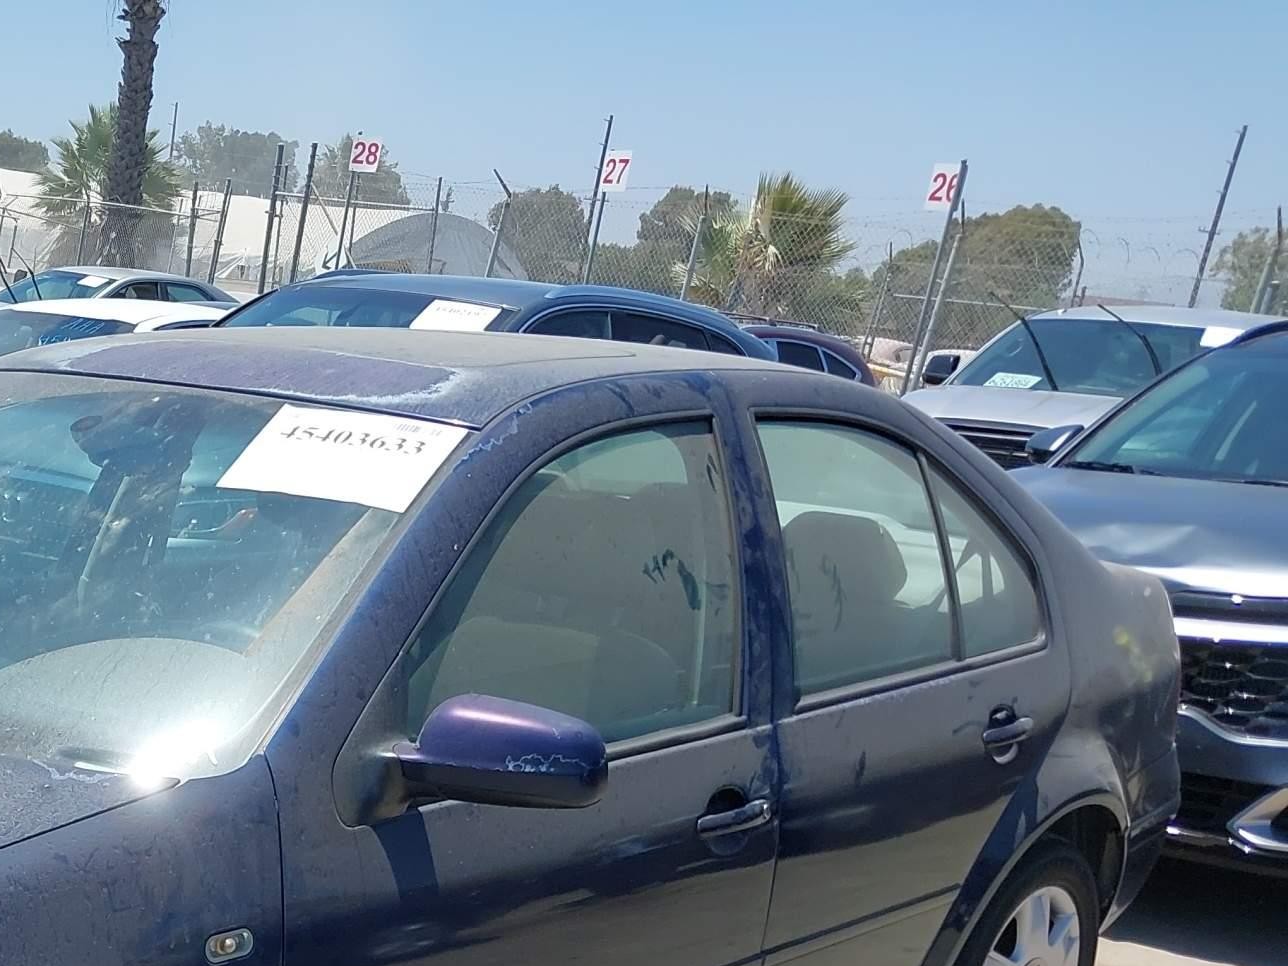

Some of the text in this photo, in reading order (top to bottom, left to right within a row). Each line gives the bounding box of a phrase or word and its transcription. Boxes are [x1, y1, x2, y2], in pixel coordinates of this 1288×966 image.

[352, 141, 379, 165] 28
[602, 158, 630, 184] 27
[280, 425, 427, 455] 45403633
